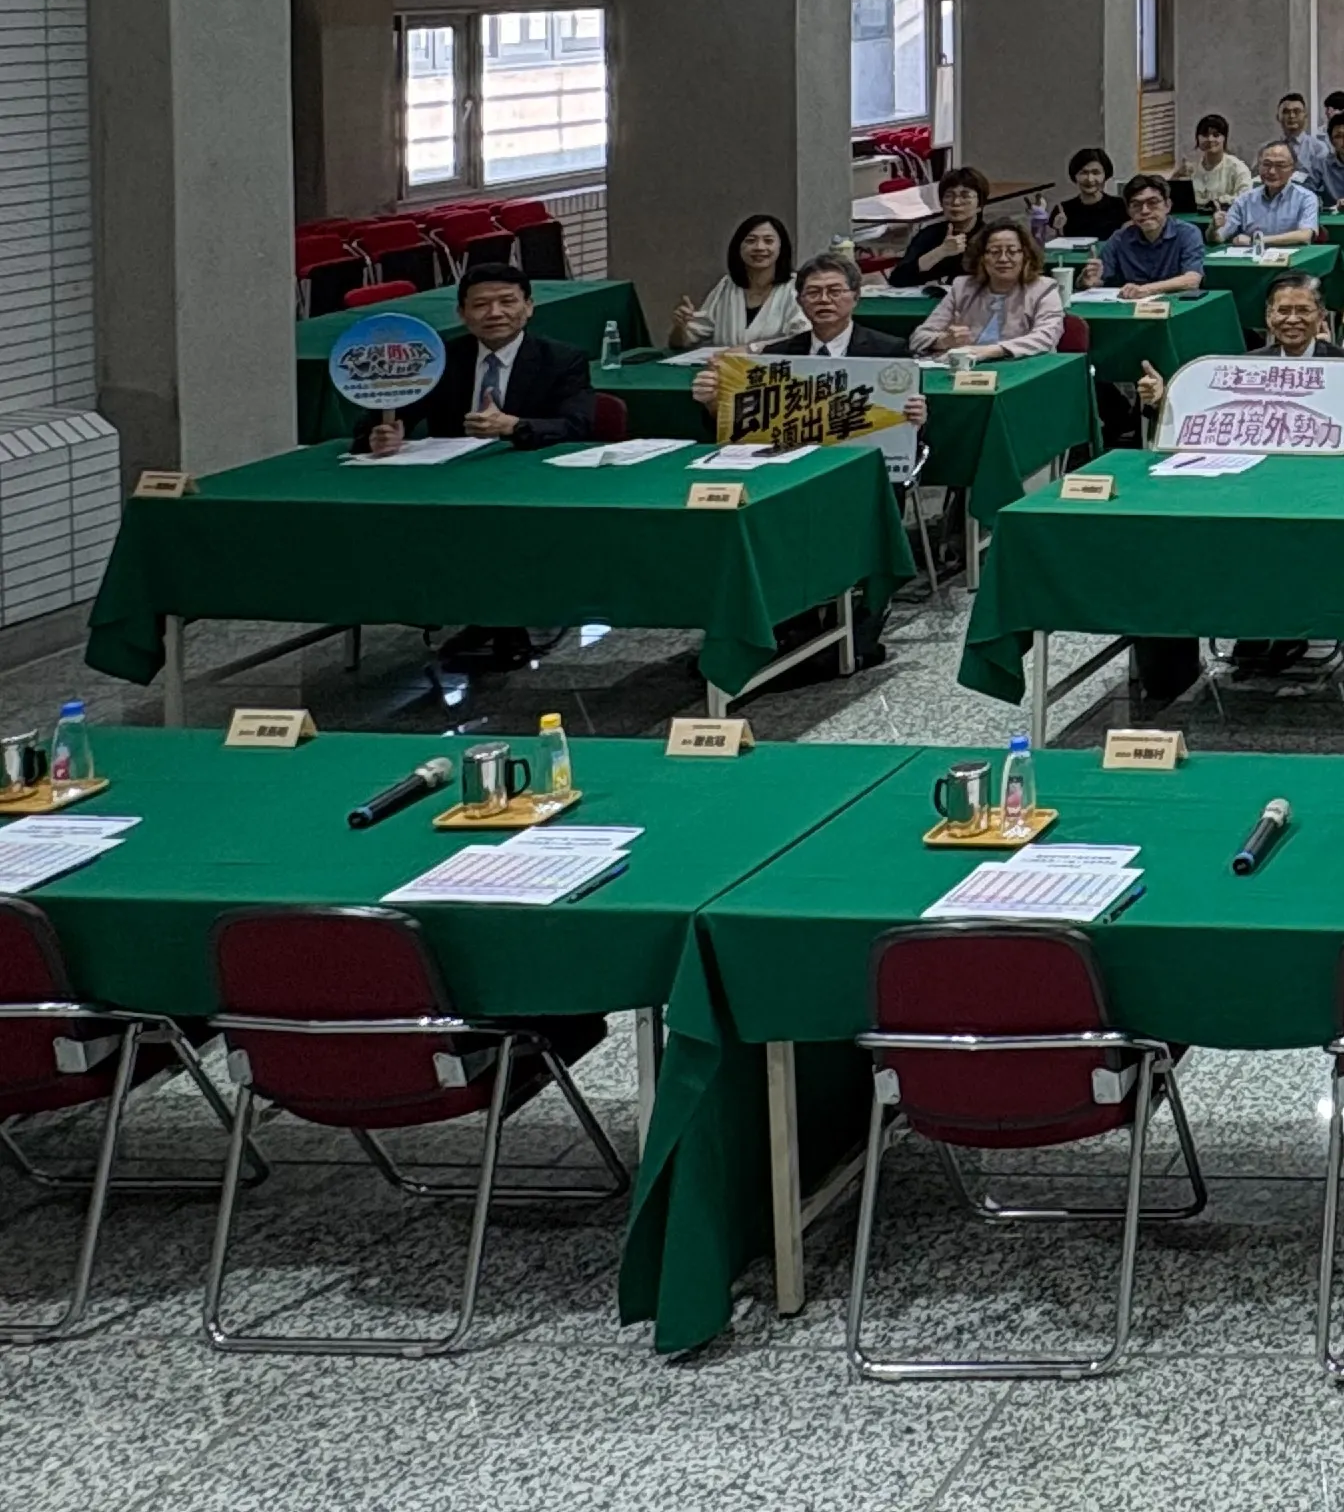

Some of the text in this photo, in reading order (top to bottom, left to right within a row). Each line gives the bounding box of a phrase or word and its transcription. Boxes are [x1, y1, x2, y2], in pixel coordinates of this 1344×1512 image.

[1176, 409, 1342, 449] 阻絕境外勢力
